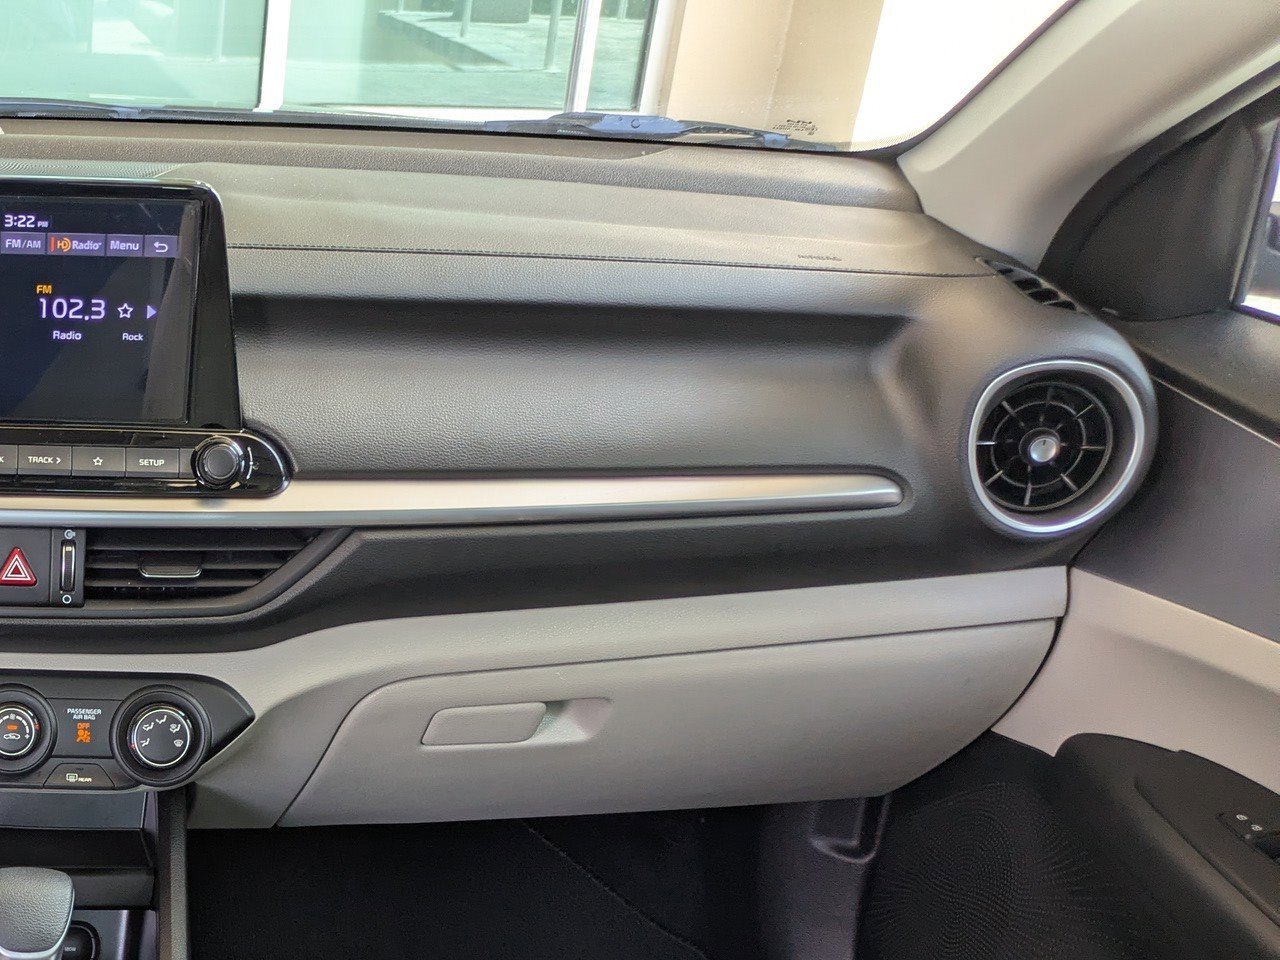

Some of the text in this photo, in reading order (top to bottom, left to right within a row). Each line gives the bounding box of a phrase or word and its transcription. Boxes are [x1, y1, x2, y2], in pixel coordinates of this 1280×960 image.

[4, 214, 49, 228] 3:22 PM
[5, 238, 42, 250] FM/AM
[72, 239, 100, 250] Radio
[109, 240, 140, 252] Menu
[36, 284, 52, 295] FM
[38, 297, 106, 321] 102.3
[52, 329, 82, 342] Radio
[122, 331, 144, 343] Rock
[27, 455, 54, 465] TRACK
[138, 458, 165, 467] SETUP
[76, 722, 91, 730] OFF
